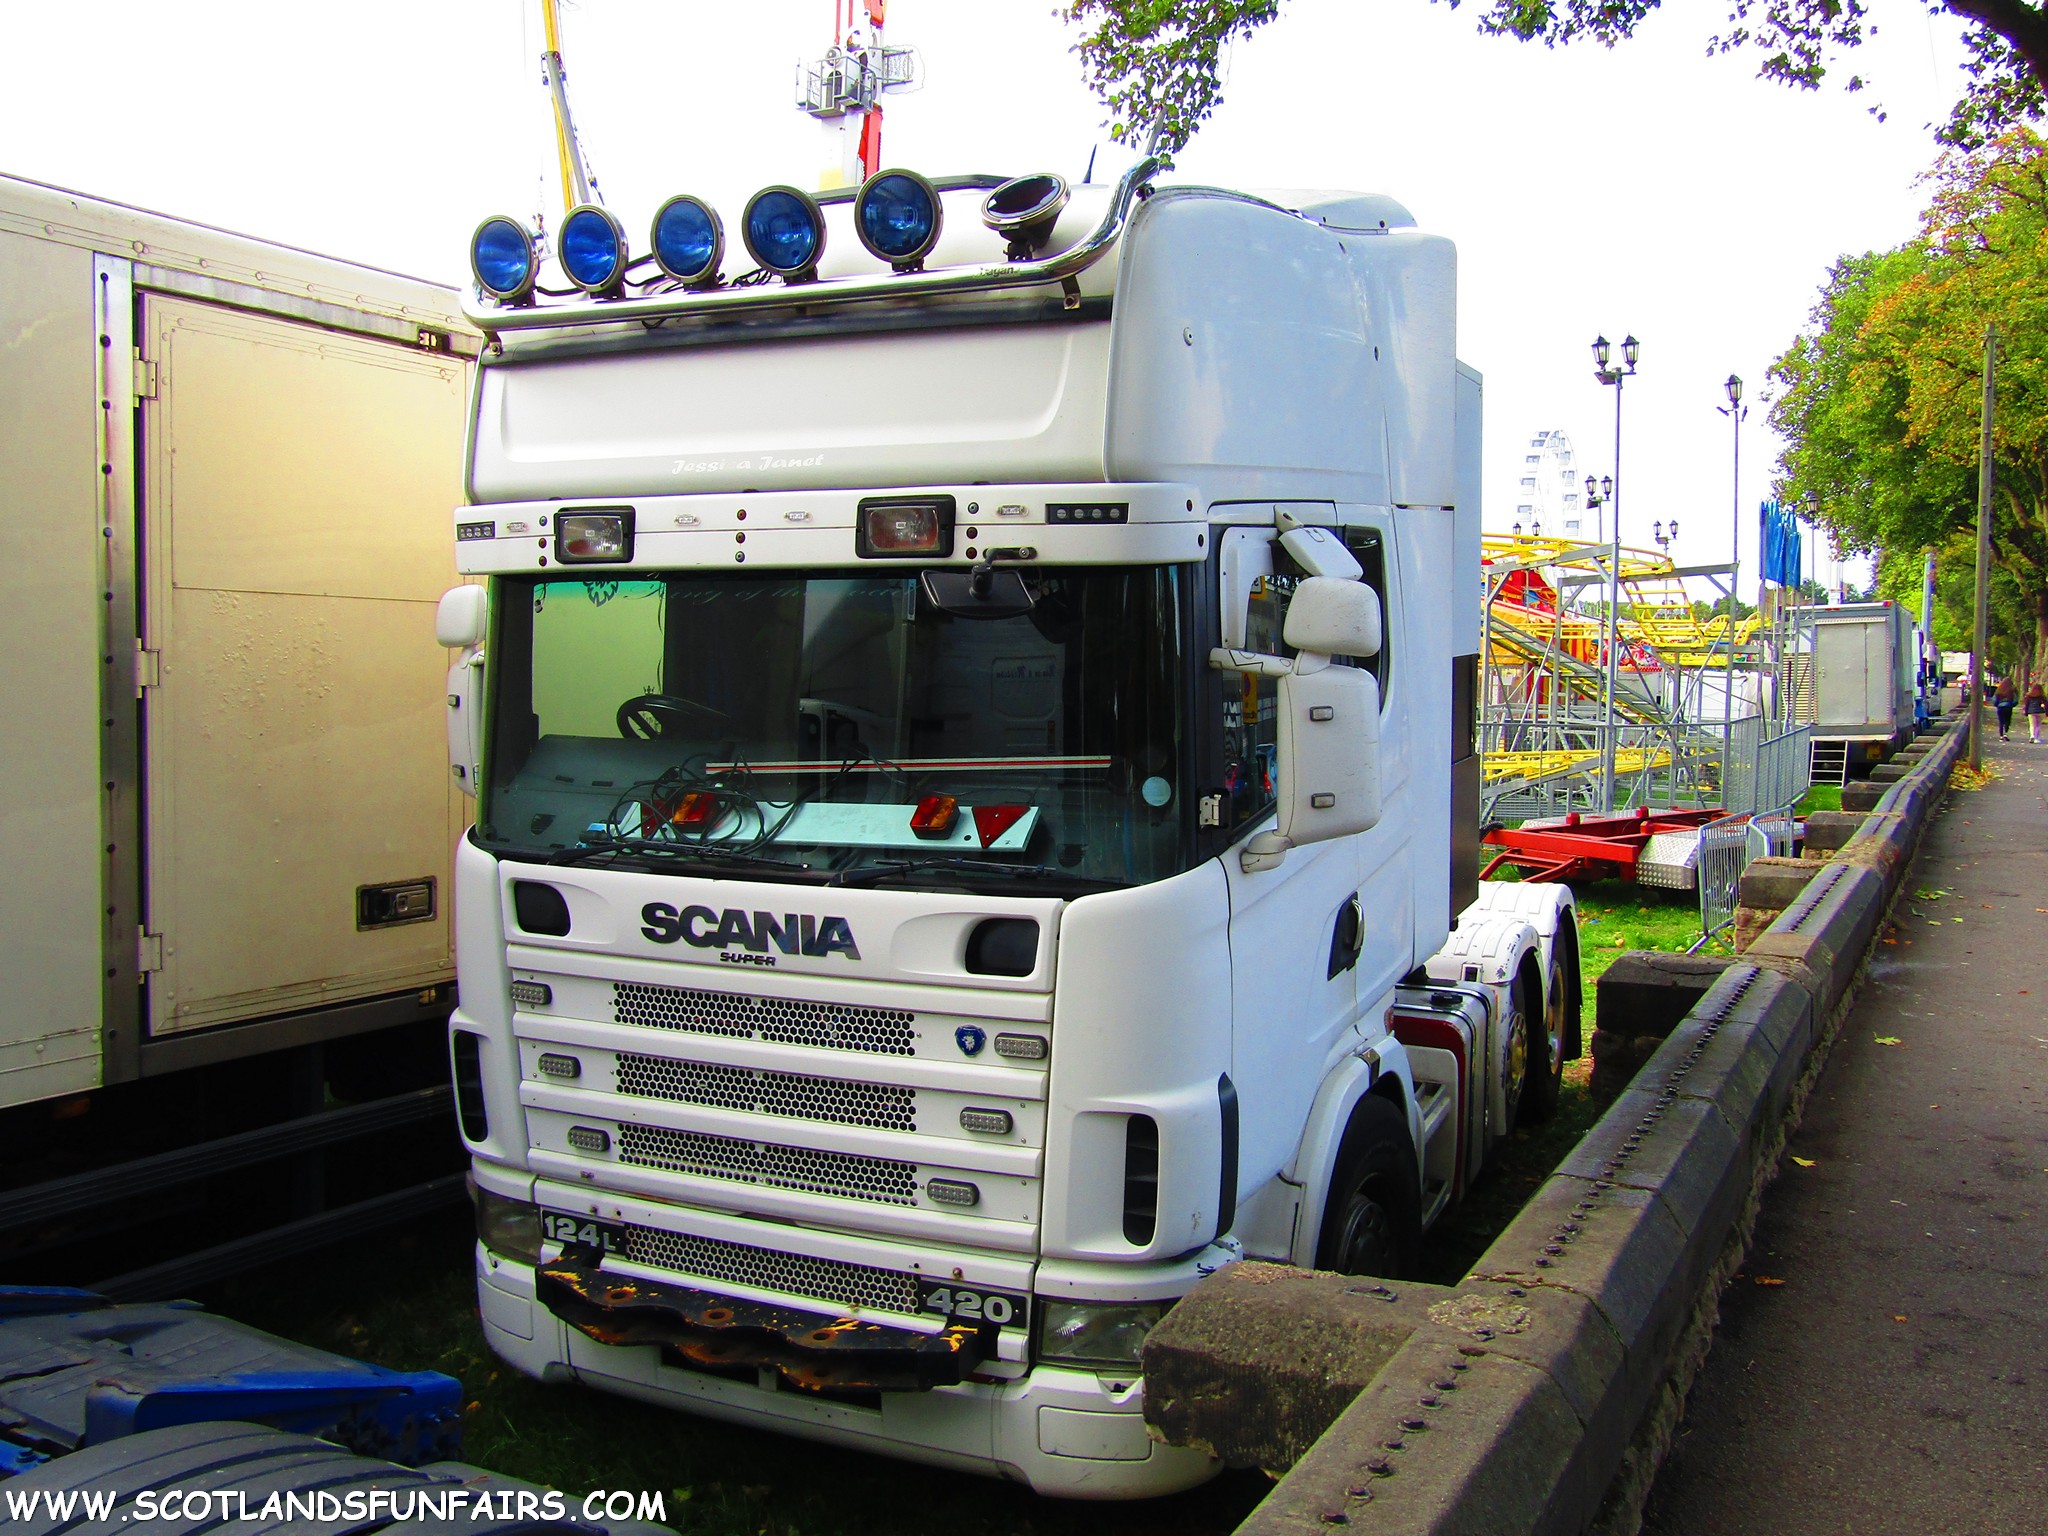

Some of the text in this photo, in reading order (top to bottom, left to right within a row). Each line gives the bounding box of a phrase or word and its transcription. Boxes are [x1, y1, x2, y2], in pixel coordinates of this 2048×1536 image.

[758, 453, 825, 472] Janet
[640, 902, 862, 960] SCANIA
[720, 951, 776, 967] SUPER
[926, 1287, 1013, 1324] 420
